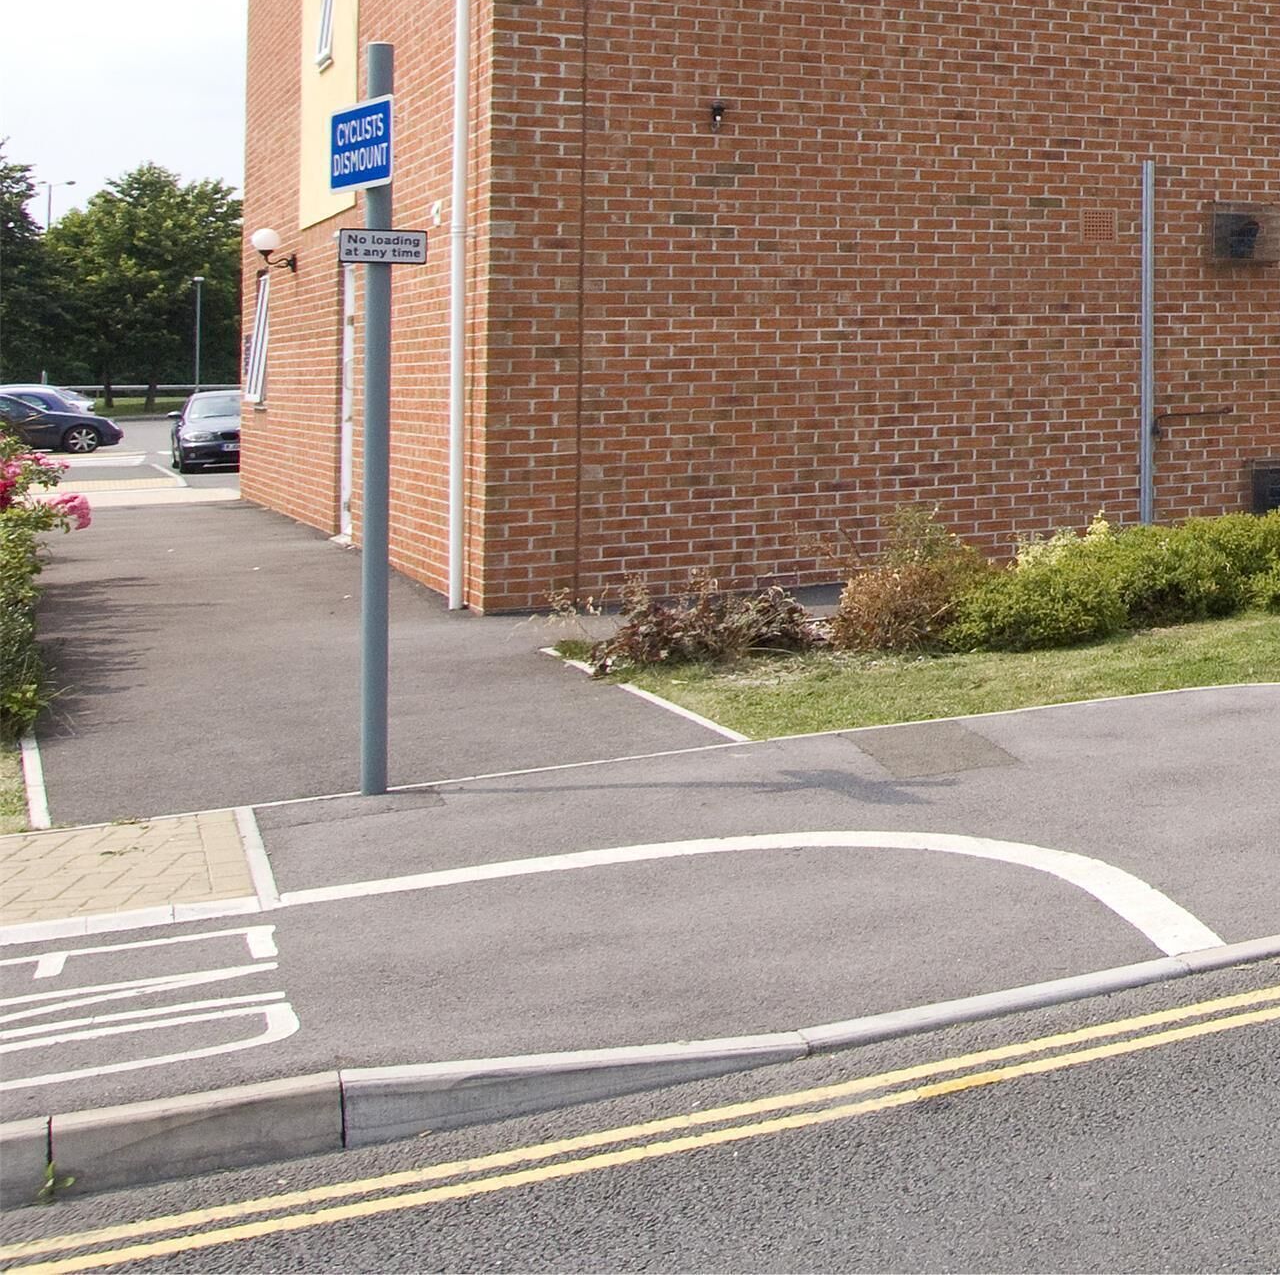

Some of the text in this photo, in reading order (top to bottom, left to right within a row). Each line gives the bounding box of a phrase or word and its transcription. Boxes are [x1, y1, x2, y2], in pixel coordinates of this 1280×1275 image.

[337, 115, 384, 147] CYCLISTS
[332, 143, 388, 177] DISMOUNT
[347, 233, 421, 248] No loading
[345, 247, 421, 259] at any time
